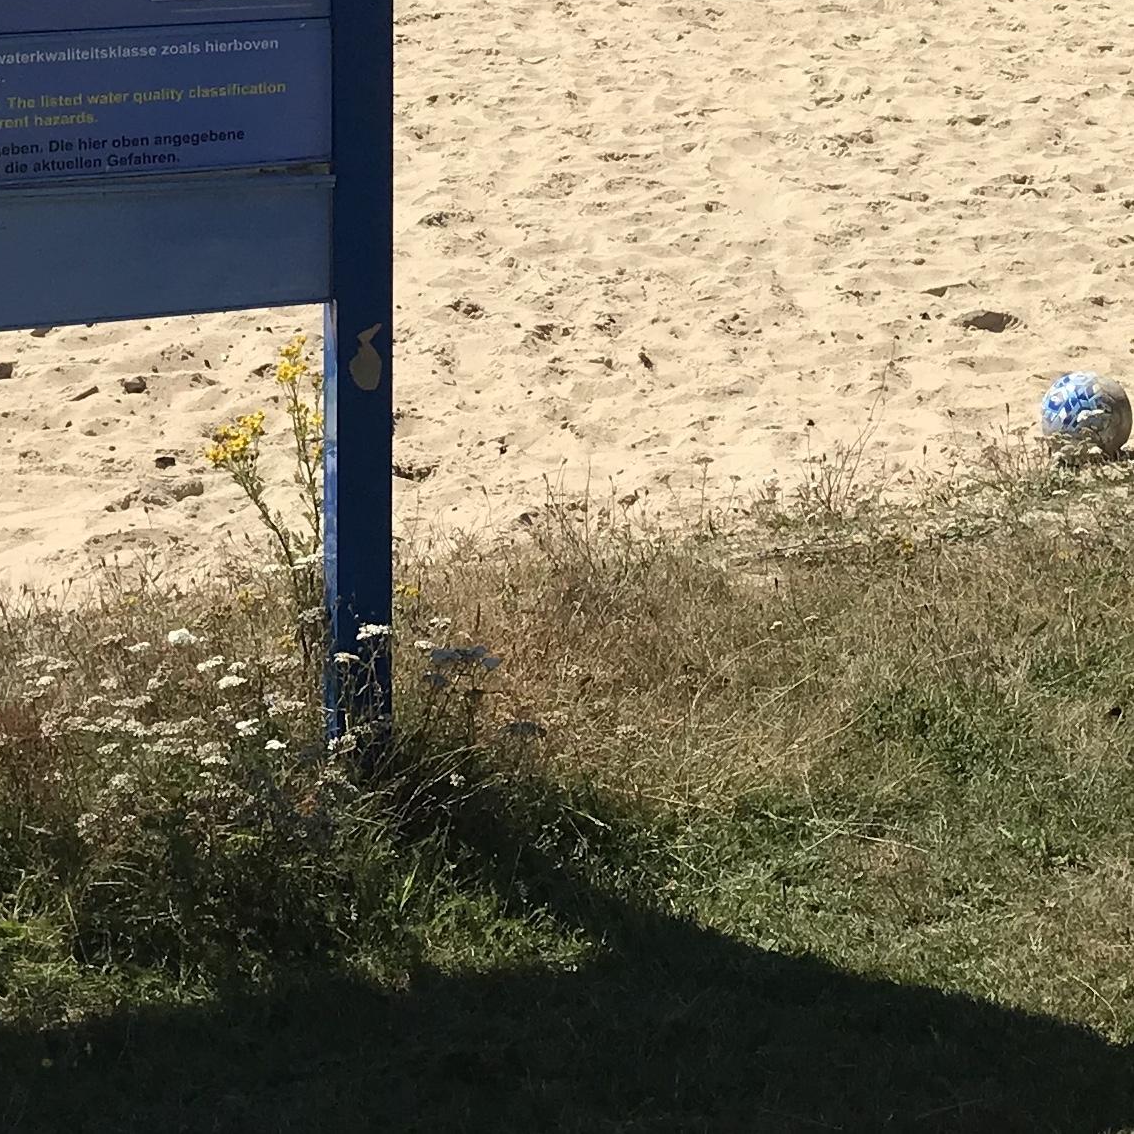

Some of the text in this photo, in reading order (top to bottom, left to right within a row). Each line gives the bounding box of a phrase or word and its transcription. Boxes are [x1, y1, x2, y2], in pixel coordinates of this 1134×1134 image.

[161, 42, 200, 55] zoals
[205, 37, 278, 53] hierboven
[7, 96, 34, 109] The
[40, 93, 82, 107] listed
[86, 91, 128, 105] water
[133, 87, 183, 105] quality
[188, 81, 285, 99] classification
[34, 111, 97, 126] hazards.
[48, 139, 73, 152] Die
[78, 137, 107, 150] hier
[111, 134, 149, 148] oben
[153, 128, 244, 148] angegebene
[4, 161, 28, 174] die
[33, 156, 101, 172] aktuellen
[107, 151, 179, 167] Gefahren.
